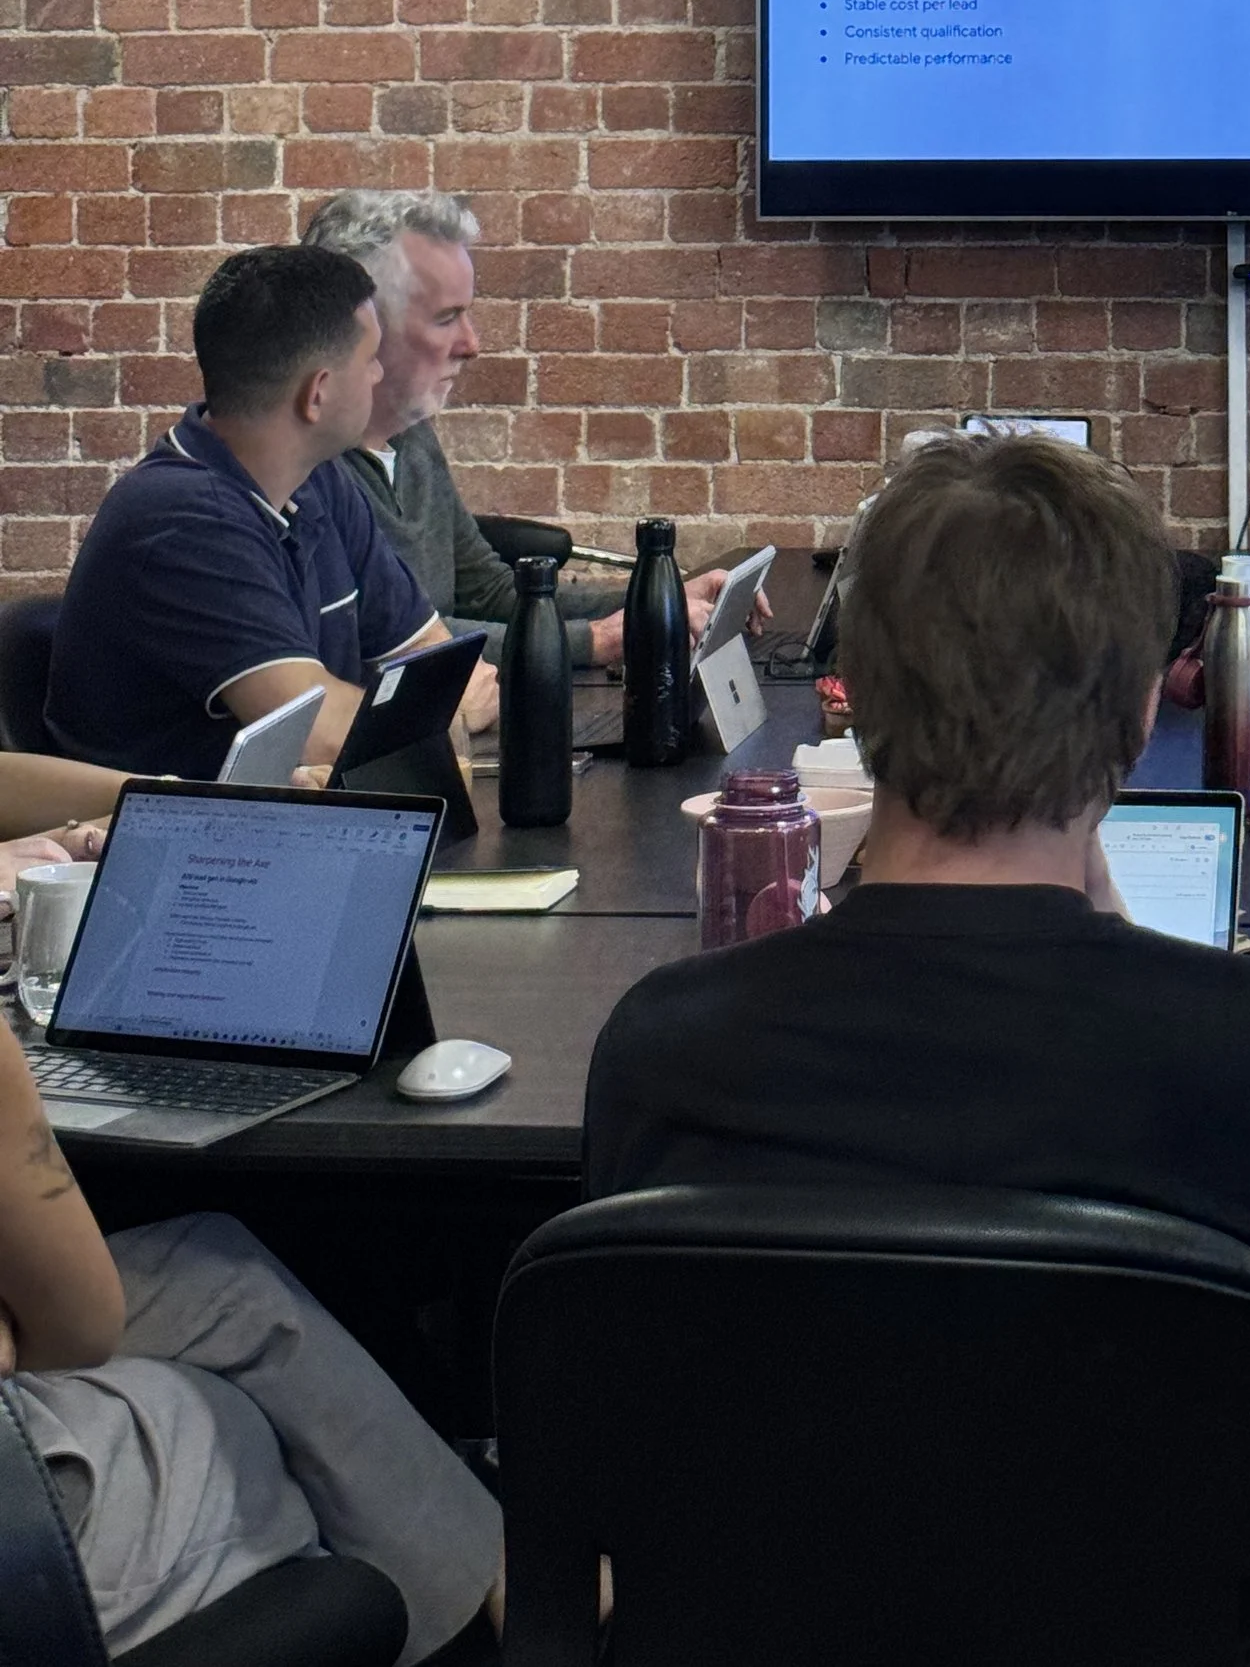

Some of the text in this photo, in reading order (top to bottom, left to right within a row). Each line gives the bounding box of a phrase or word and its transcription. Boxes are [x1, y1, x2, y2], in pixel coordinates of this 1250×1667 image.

[889, 0, 920, 11] cost
[922, 0, 946, 13] per
[844, 24, 1004, 40] Consistent qualification
[844, 51, 1013, 68] Predictable performance
